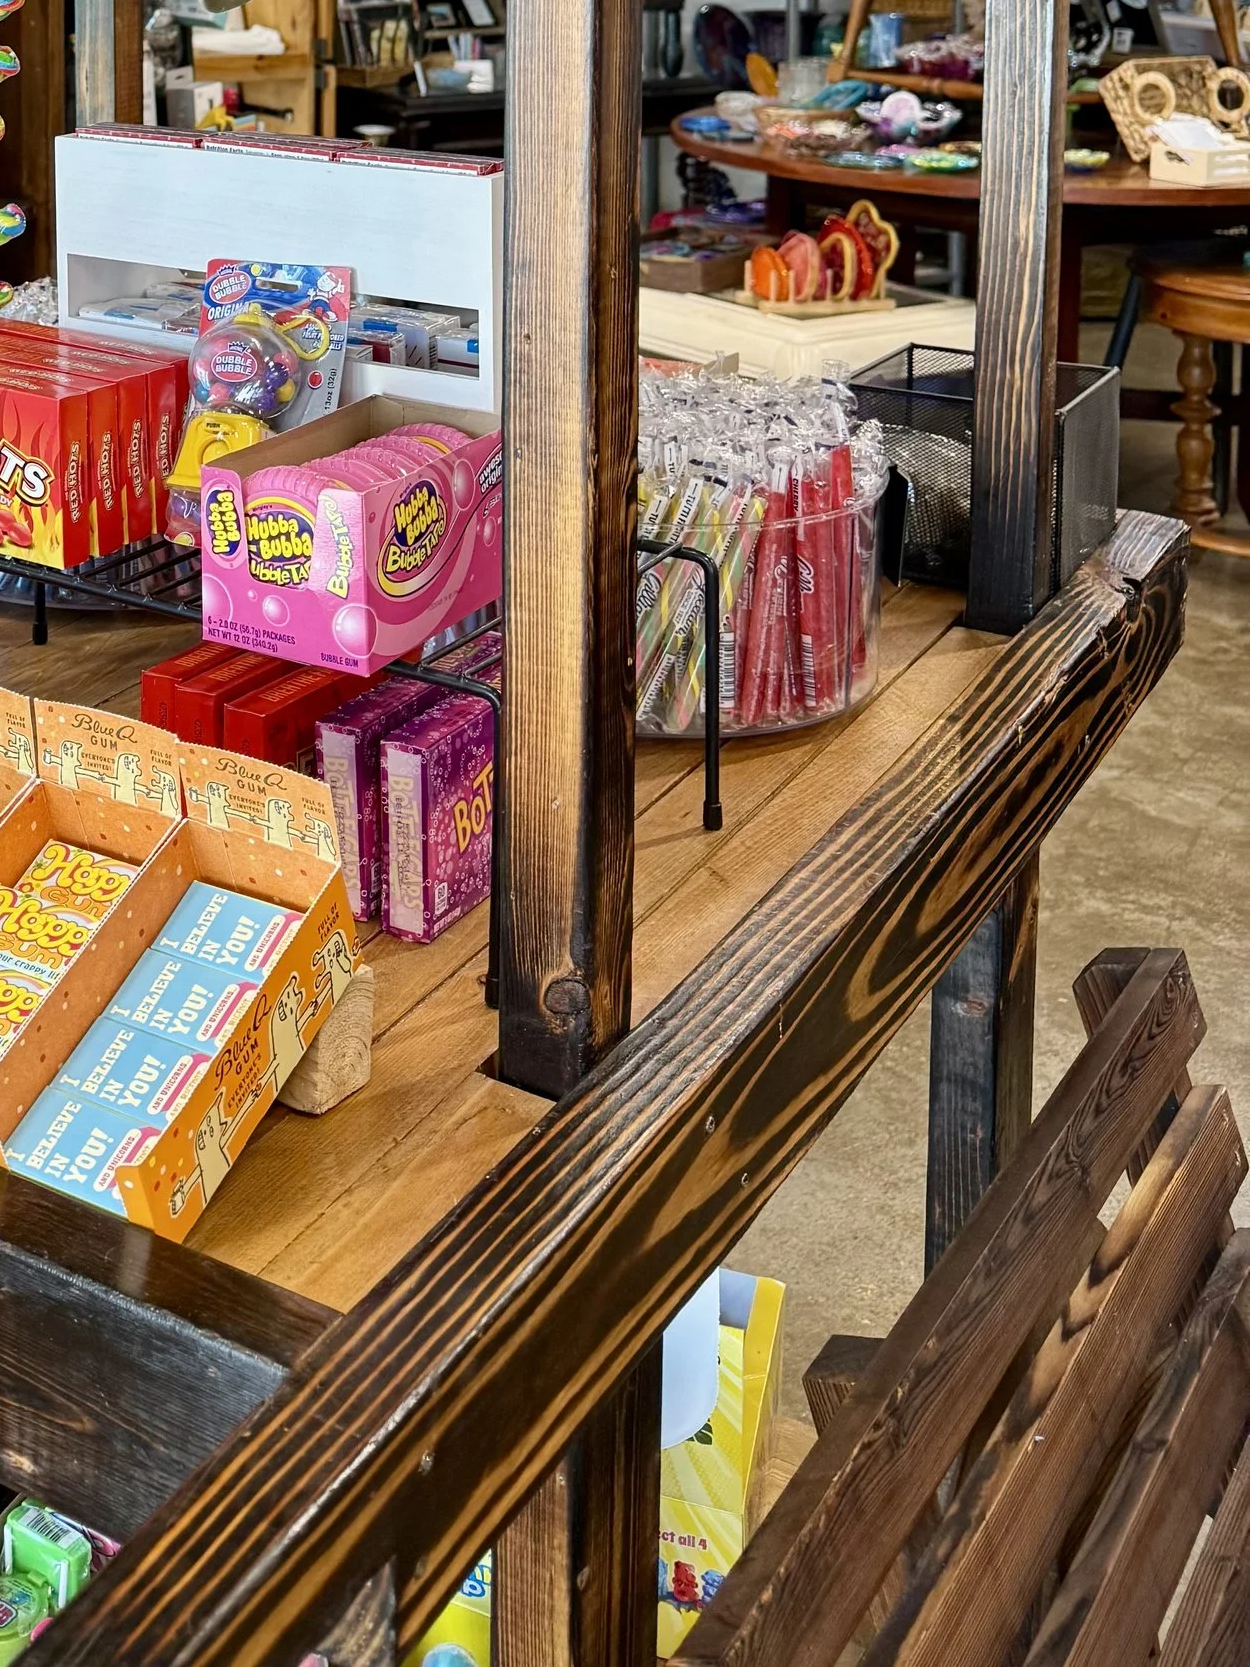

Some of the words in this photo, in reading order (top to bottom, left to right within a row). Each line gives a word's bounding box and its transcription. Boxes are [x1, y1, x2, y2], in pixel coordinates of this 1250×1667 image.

[212, 275, 246, 292] DUBBLE
[215, 284, 247, 300] BUBBLE
[215, 365, 252, 376] BUBBLE
[216, 356, 253, 366] DUBBLE
[68, 441, 80, 485] HOTS
[394, 485, 429, 533] Hubba
[246, 514, 299, 541] Hubba
[406, 500, 440, 547] Bubba
[260, 532, 313, 562] Bubba
[208, 628, 221, 638] NET
[222, 630, 232, 640] WT
[234, 632, 240, 642] 12
[242, 634, 250, 644] OZ
[230, 620, 238, 631] OZ
[262, 630, 296, 646] PACKAGES
[320, 652, 344, 666] BUBBLE
[344, 656, 359, 668] GUM
[71, 713, 115, 736] Blue
[116, 725, 138, 744] Q
[91, 736, 118, 751] GUM
[215, 757, 261, 782] Blue
[264, 772, 287, 791] Q
[237, 780, 267, 797] GUM
[14, 960, 47, 977] crappy
[48, 971, 60, 980] lif
[130, 960, 182, 1025] BELIEVE
[208, 987, 237, 1023] UNICORNS
[111, 1004, 131, 1019] I
[149, 1007, 174, 1031] IN
[167, 984, 215, 1035] YOU!
[214, 1026, 254, 1091] Blue
[251, 994, 272, 1032] Q
[234, 1037, 260, 1077] GUM
[26, 1100, 82, 1171] BELIEVE
[5, 1147, 26, 1162] I
[45, 1153, 70, 1179] IN
[63, 1127, 115, 1185] YOU!
[108, 1135, 137, 1173] UNICORNS
[678, 1535, 695, 1547] all
[698, 1538, 707, 1550] 4
